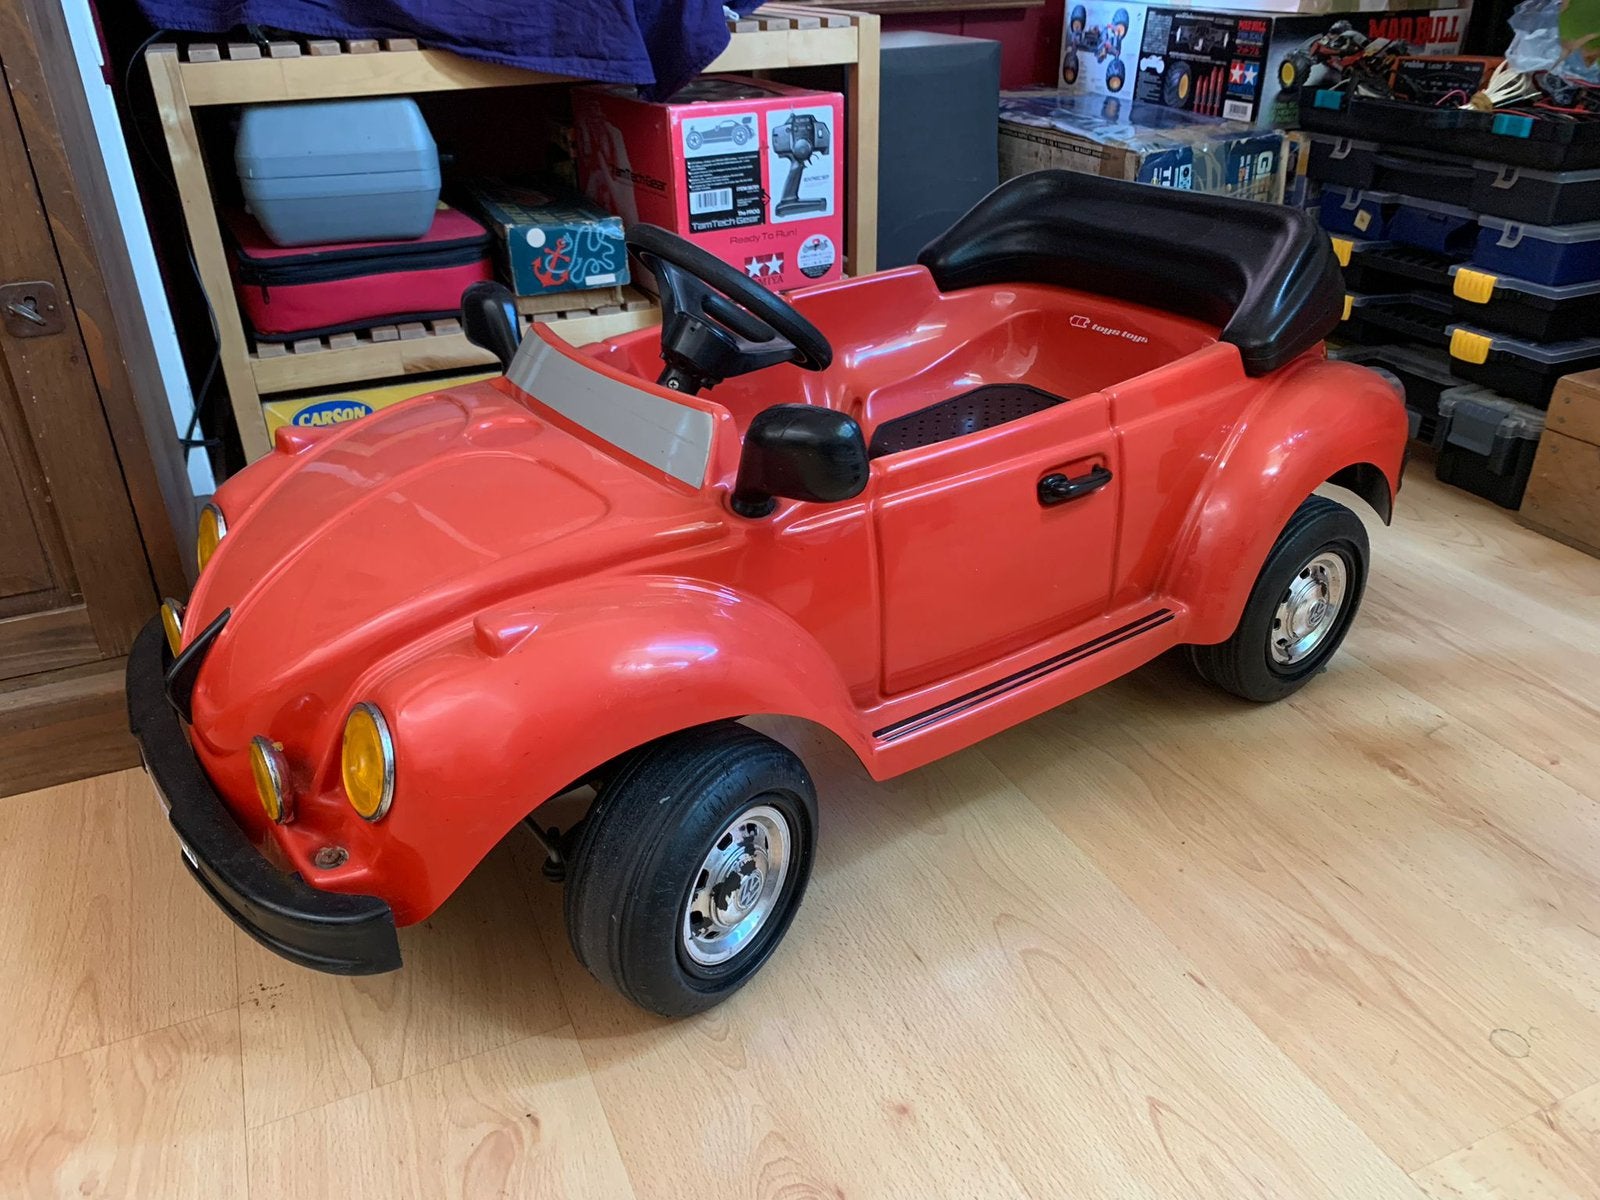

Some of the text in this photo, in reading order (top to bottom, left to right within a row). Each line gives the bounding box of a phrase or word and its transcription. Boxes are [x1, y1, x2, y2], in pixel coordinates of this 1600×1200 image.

[1415, 15, 1460, 46] BULL
[729, 229, 797, 244] Ready To Run!
[299, 405, 366, 427] CARSON
